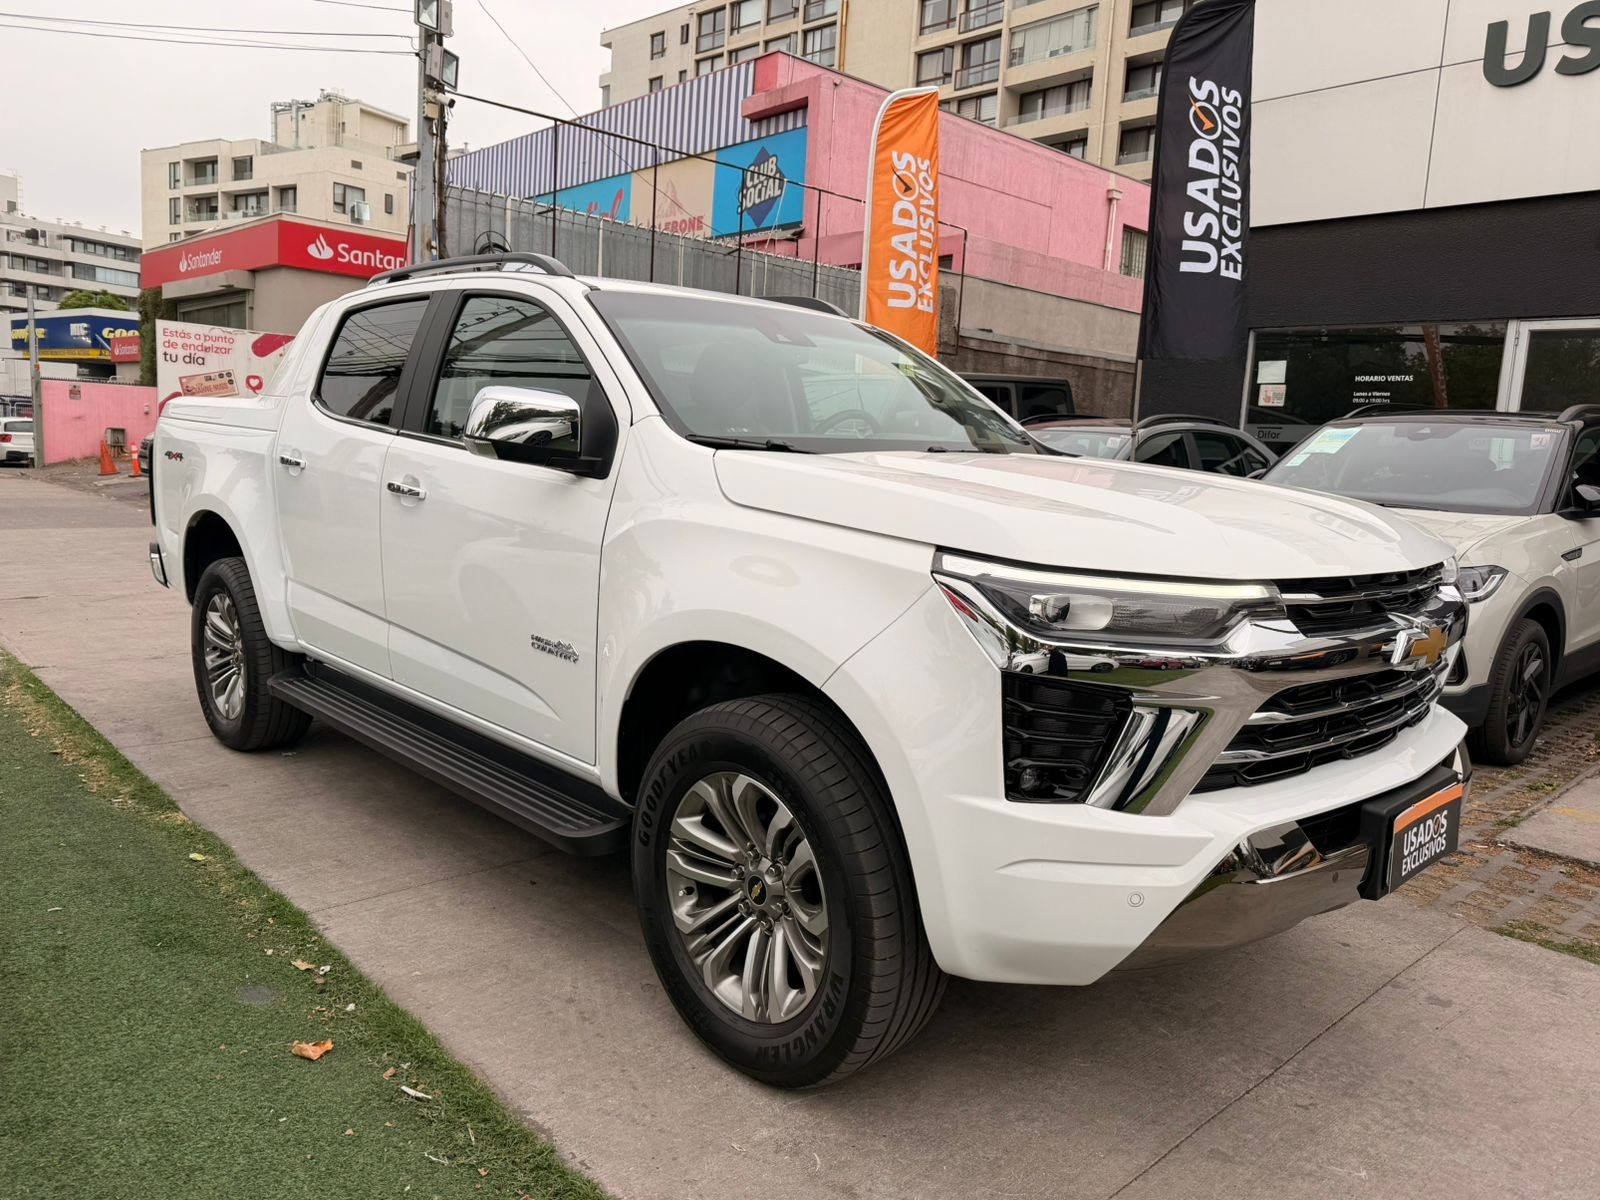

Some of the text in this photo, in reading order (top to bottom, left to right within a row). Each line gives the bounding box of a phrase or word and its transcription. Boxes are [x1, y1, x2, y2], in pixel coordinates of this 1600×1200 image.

[1483, 0, 1600, 87] US
[746, 156, 777, 188] CLUB
[1179, 76, 1222, 274] USADOS
[1220, 86, 1242, 281] EXCLUSIVOS
[887, 151, 919, 309] USADOS
[917, 157, 935, 314] EXCLUSIVOS
[187, 249, 222, 271] Santander
[162, 327, 235, 345] Estás a punto
[162, 339, 233, 355] de endulzar
[162, 351, 205, 366] tu día
[1257, 430, 1280, 440] Difor
[1403, 810, 1448, 856] USADOS
[1401, 834, 1447, 877] EXCLUSIVOS
